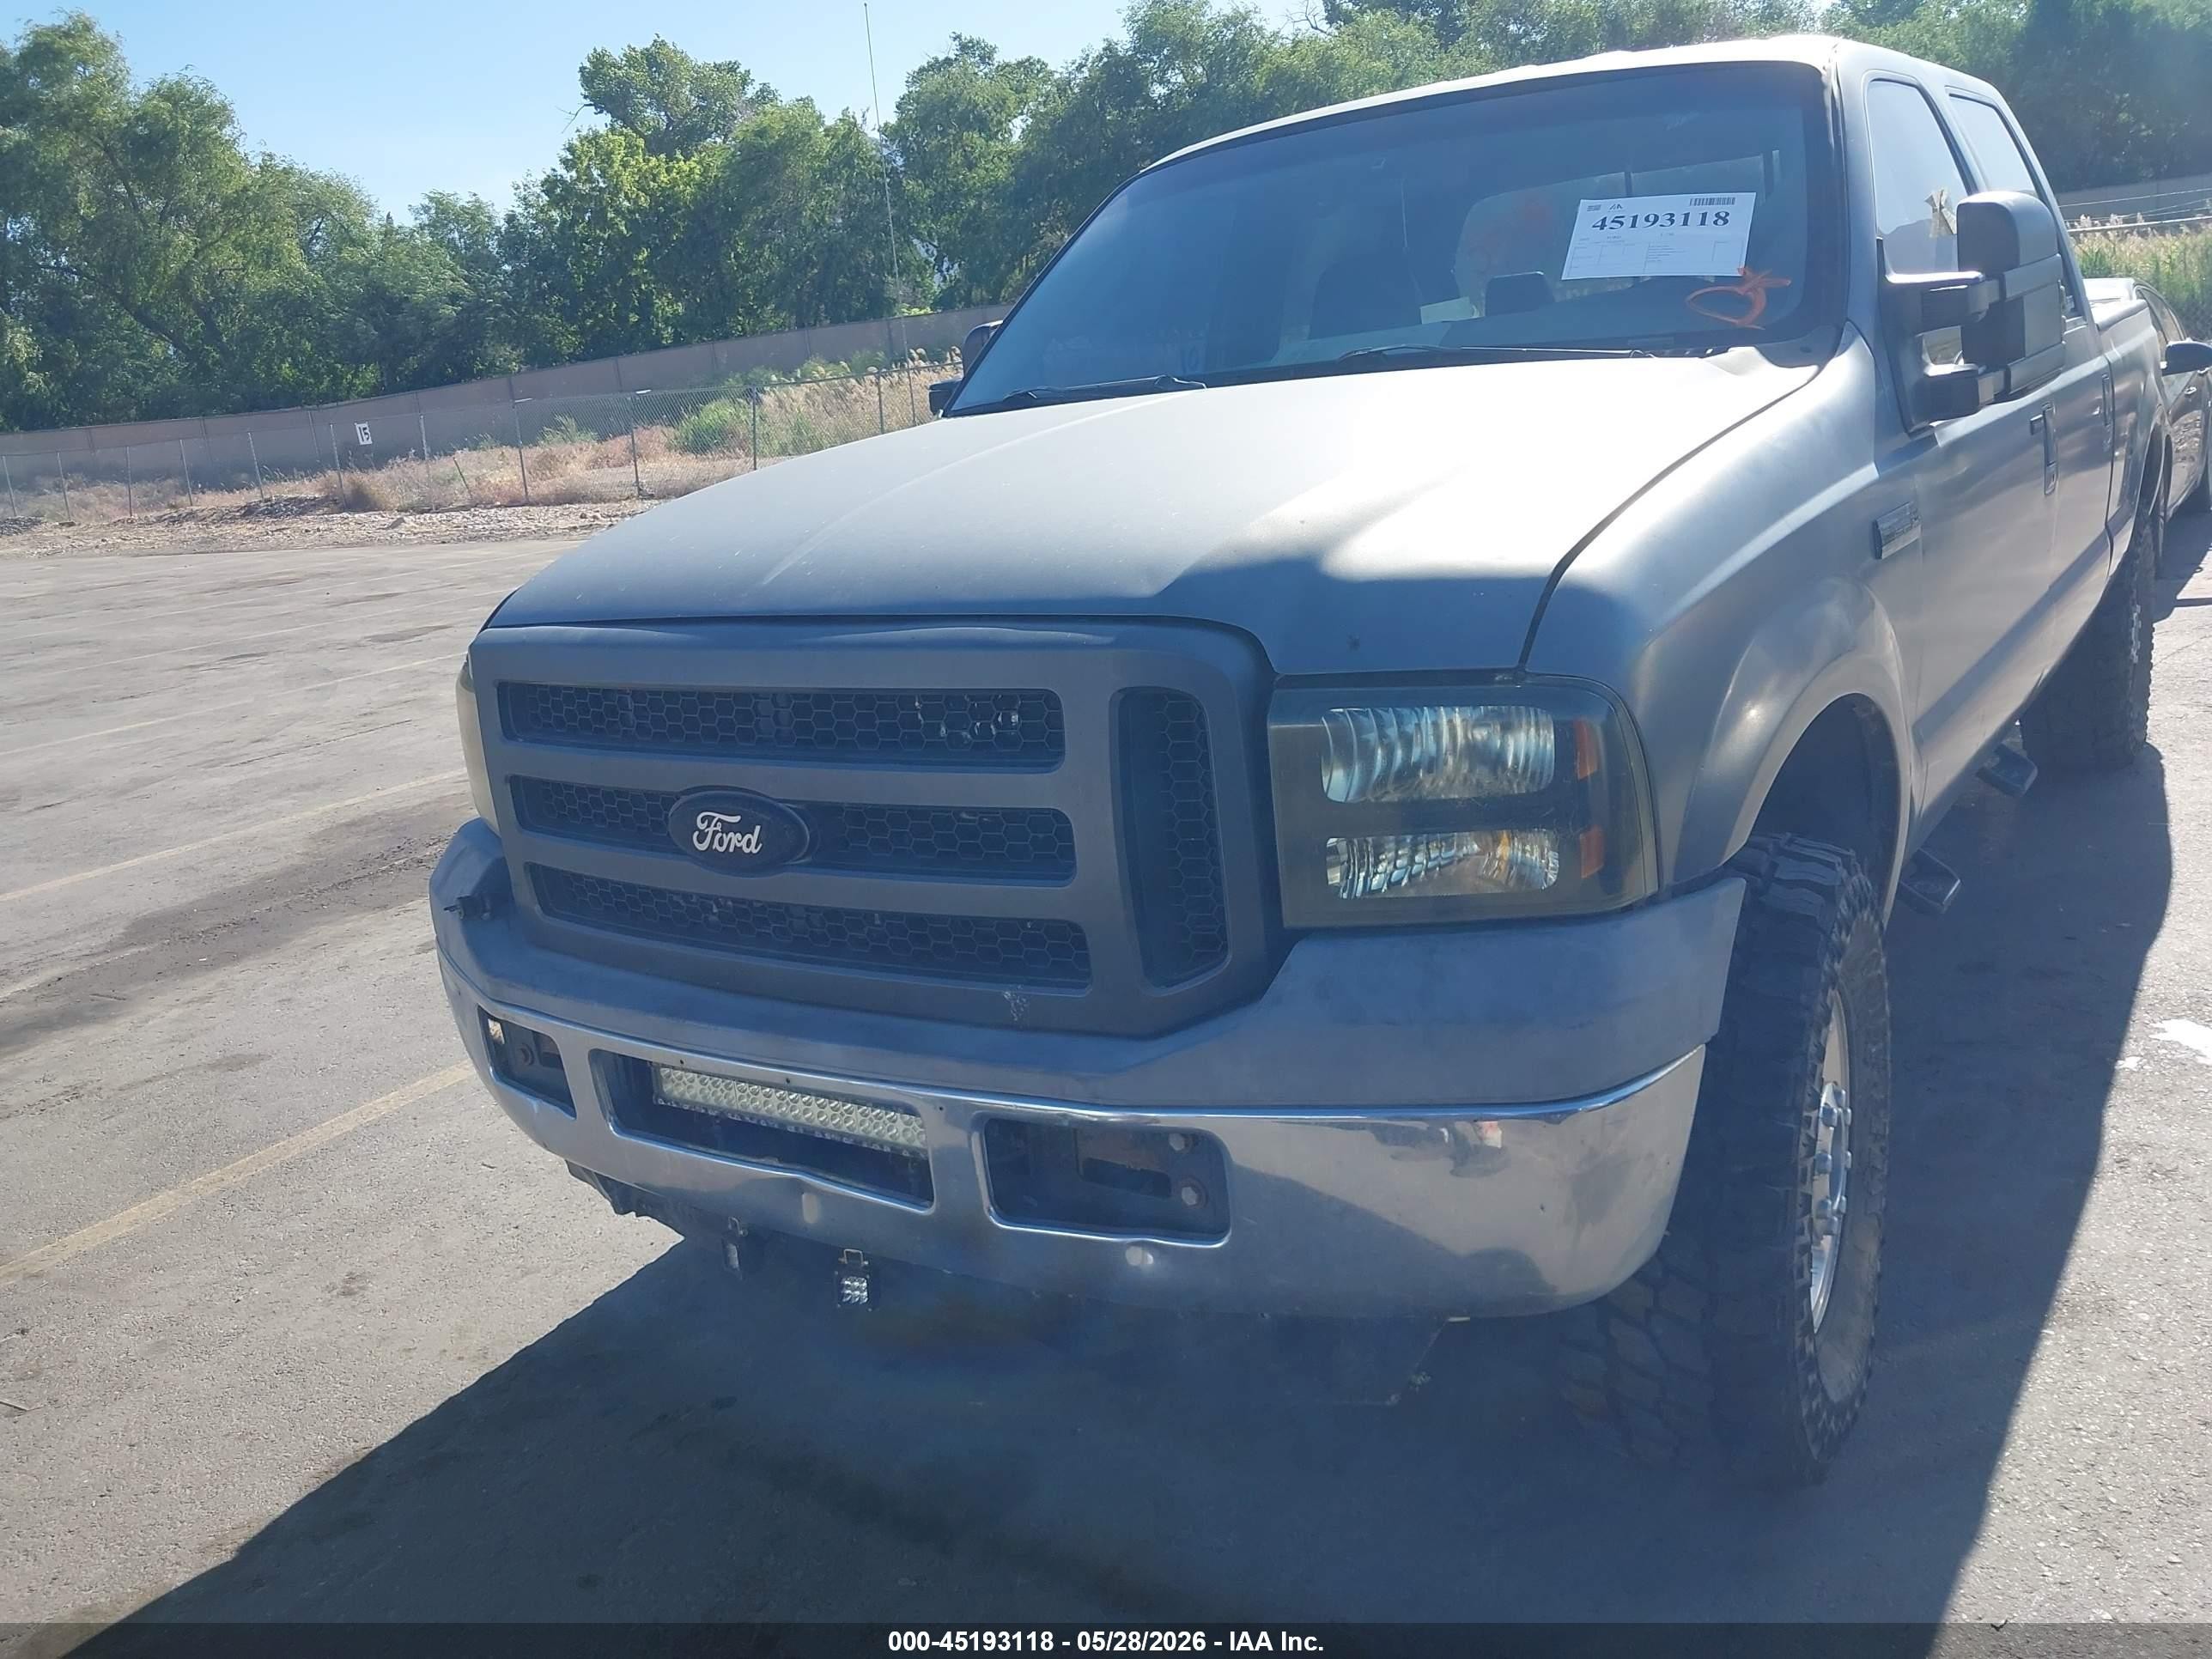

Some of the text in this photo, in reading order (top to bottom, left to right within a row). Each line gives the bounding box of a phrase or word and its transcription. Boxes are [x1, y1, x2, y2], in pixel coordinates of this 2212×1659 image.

[1592, 211, 1730, 230] 45193118
[358, 426, 370, 442] 15
[692, 811, 763, 854] Ford
